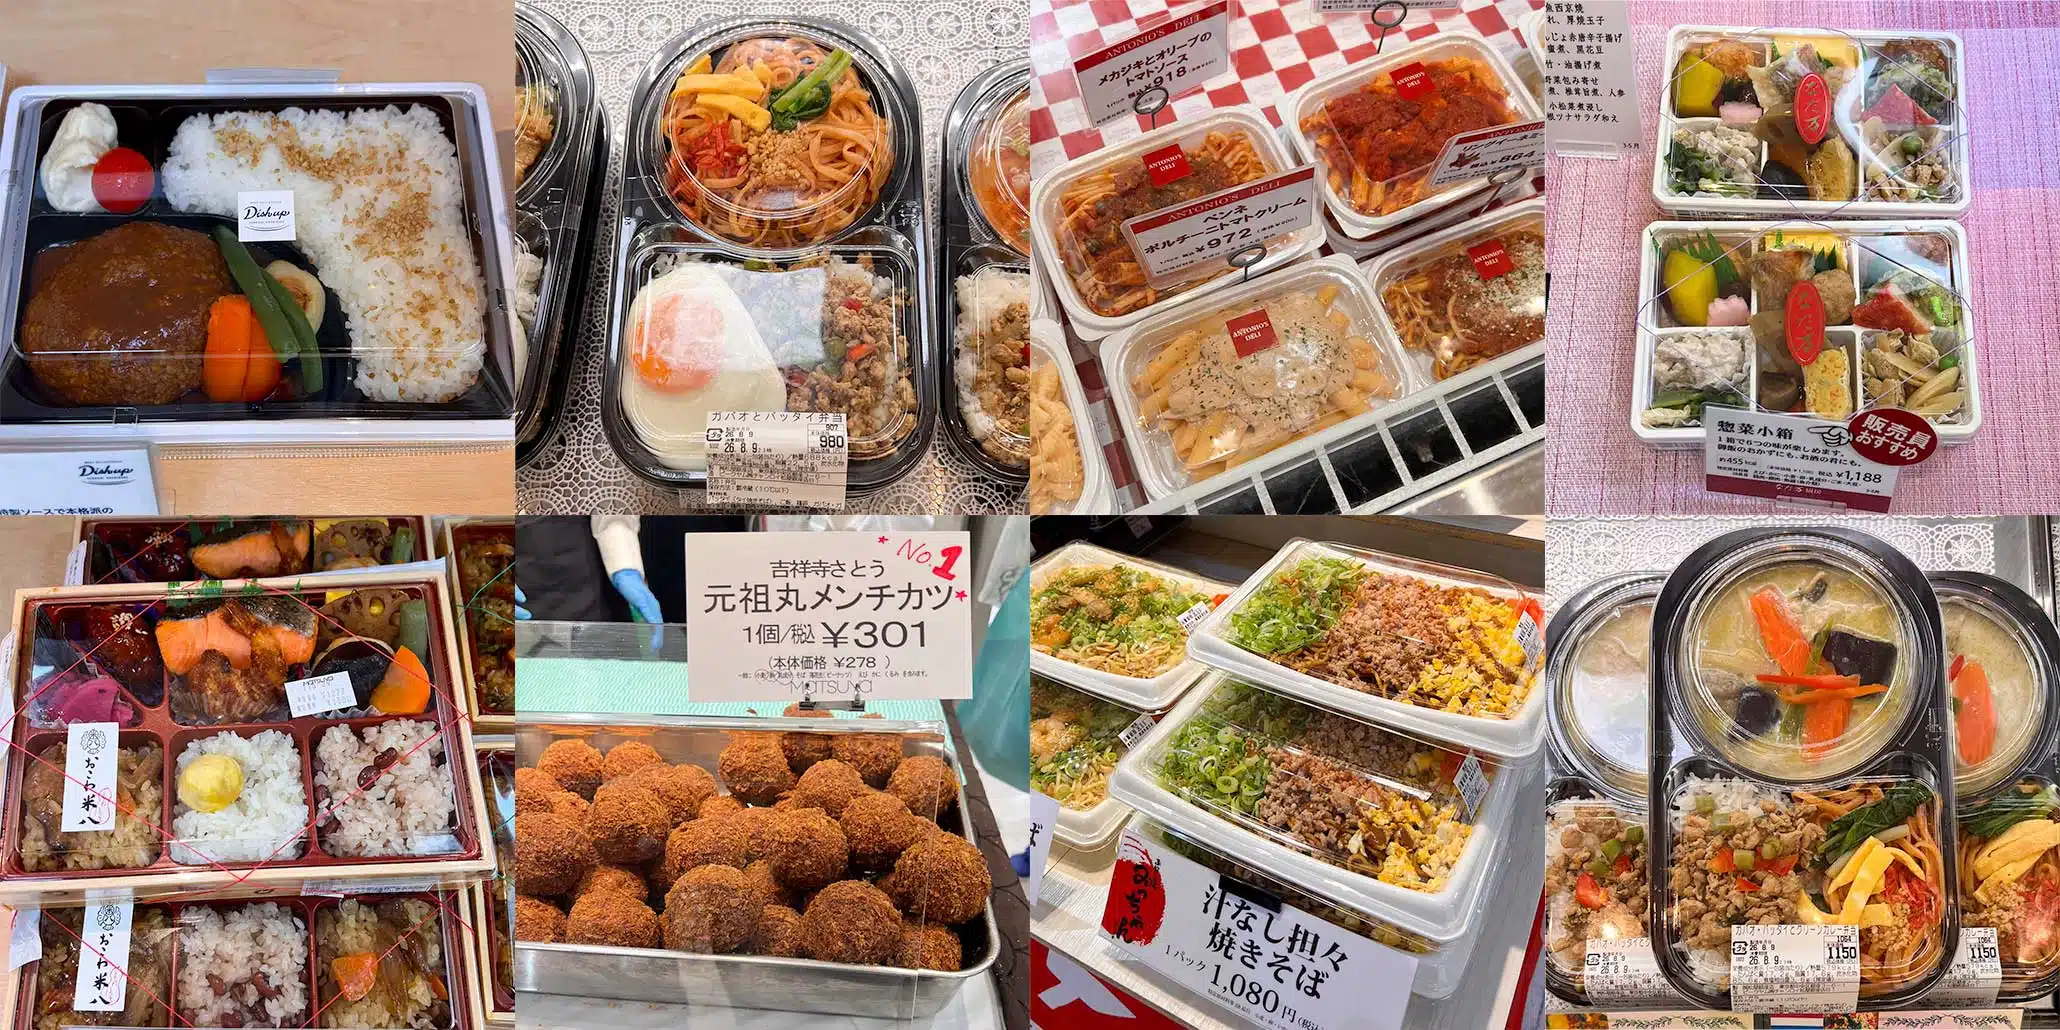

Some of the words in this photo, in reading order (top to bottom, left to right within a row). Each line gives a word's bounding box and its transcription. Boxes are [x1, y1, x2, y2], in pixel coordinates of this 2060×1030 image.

[1105, 28, 1165, 59] ANTONIO'S
[1175, 14, 1202, 30] DELI
[1098, 31, 1212, 86] メカジキとオリーブの
[1126, 53, 1189, 87] トマトソース
[1159, 162, 1176, 171] DELI
[1168, 193, 1239, 222] ANTONIO'S
[1251, 180, 1281, 195] DELI
[1203, 205, 1249, 223] ペンネ
[1195, 228, 1252, 253] ¥972
[1245, 331, 1262, 341] DELI
[819, 435, 844, 448] 980
[1717, 420, 1794, 440] 惣菜小箱
[1861, 413, 1931, 449] 販売員
[1856, 430, 1918, 460] おすすめ
[1836, 470, 1882, 484] ¥1,188
[769, 559, 885, 579] 吉祥寺さとう
[704, 581, 953, 614] 元祖丸メンチカツ
[742, 623, 816, 645] 1個/税込
[821, 621, 926, 648] ¥301
[833, 656, 876, 669] ¥278
[1202, 884, 1348, 972] 汁なし担々
[1206, 921, 1329, 999] 焼きそば
[1828, 946, 1857, 960] 1150
[1971, 947, 1996, 959] 1150
[1211, 964, 1279, 1014] 1,080
